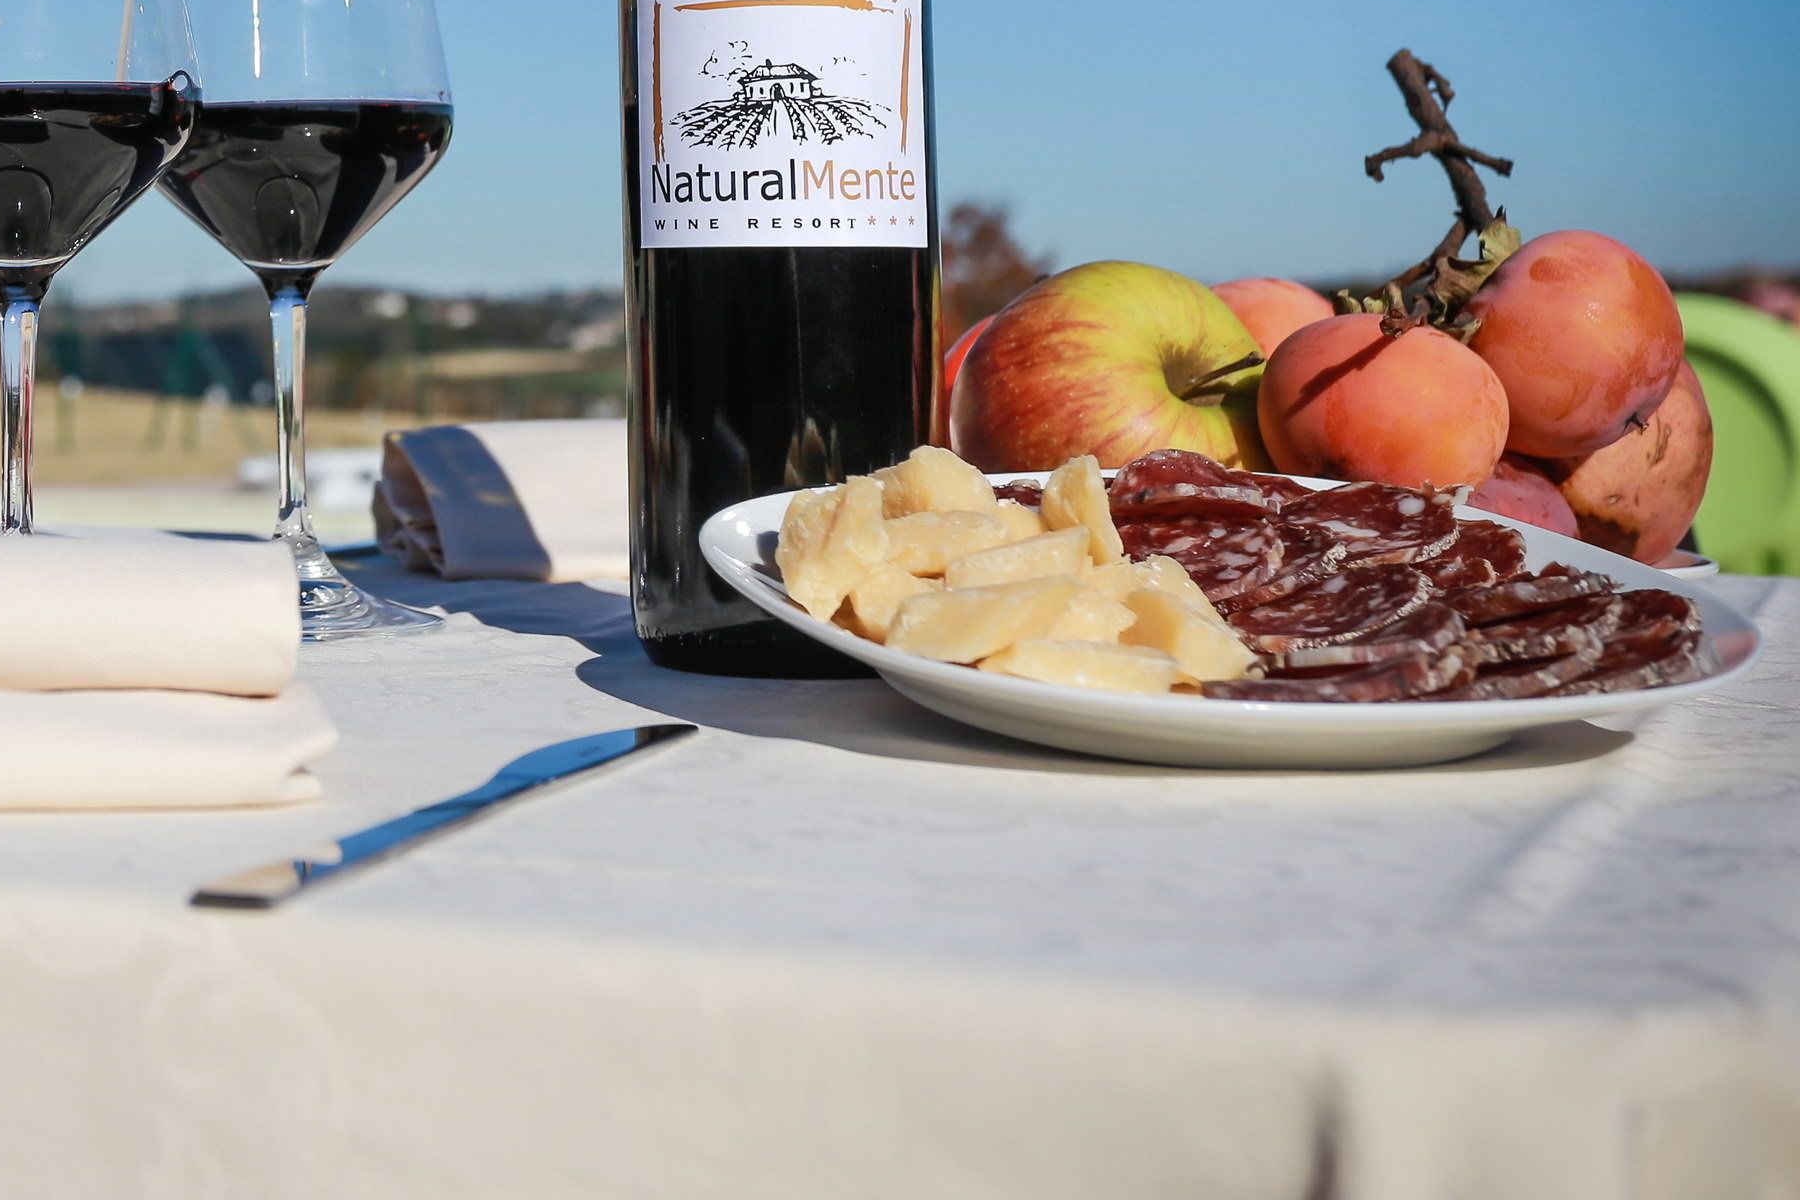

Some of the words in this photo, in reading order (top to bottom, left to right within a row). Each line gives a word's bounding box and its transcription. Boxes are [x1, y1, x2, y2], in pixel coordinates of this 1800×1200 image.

[651, 158, 916, 204] NaturalMente
[654, 218, 719, 230] WINE
[747, 217, 857, 230] RESORT
